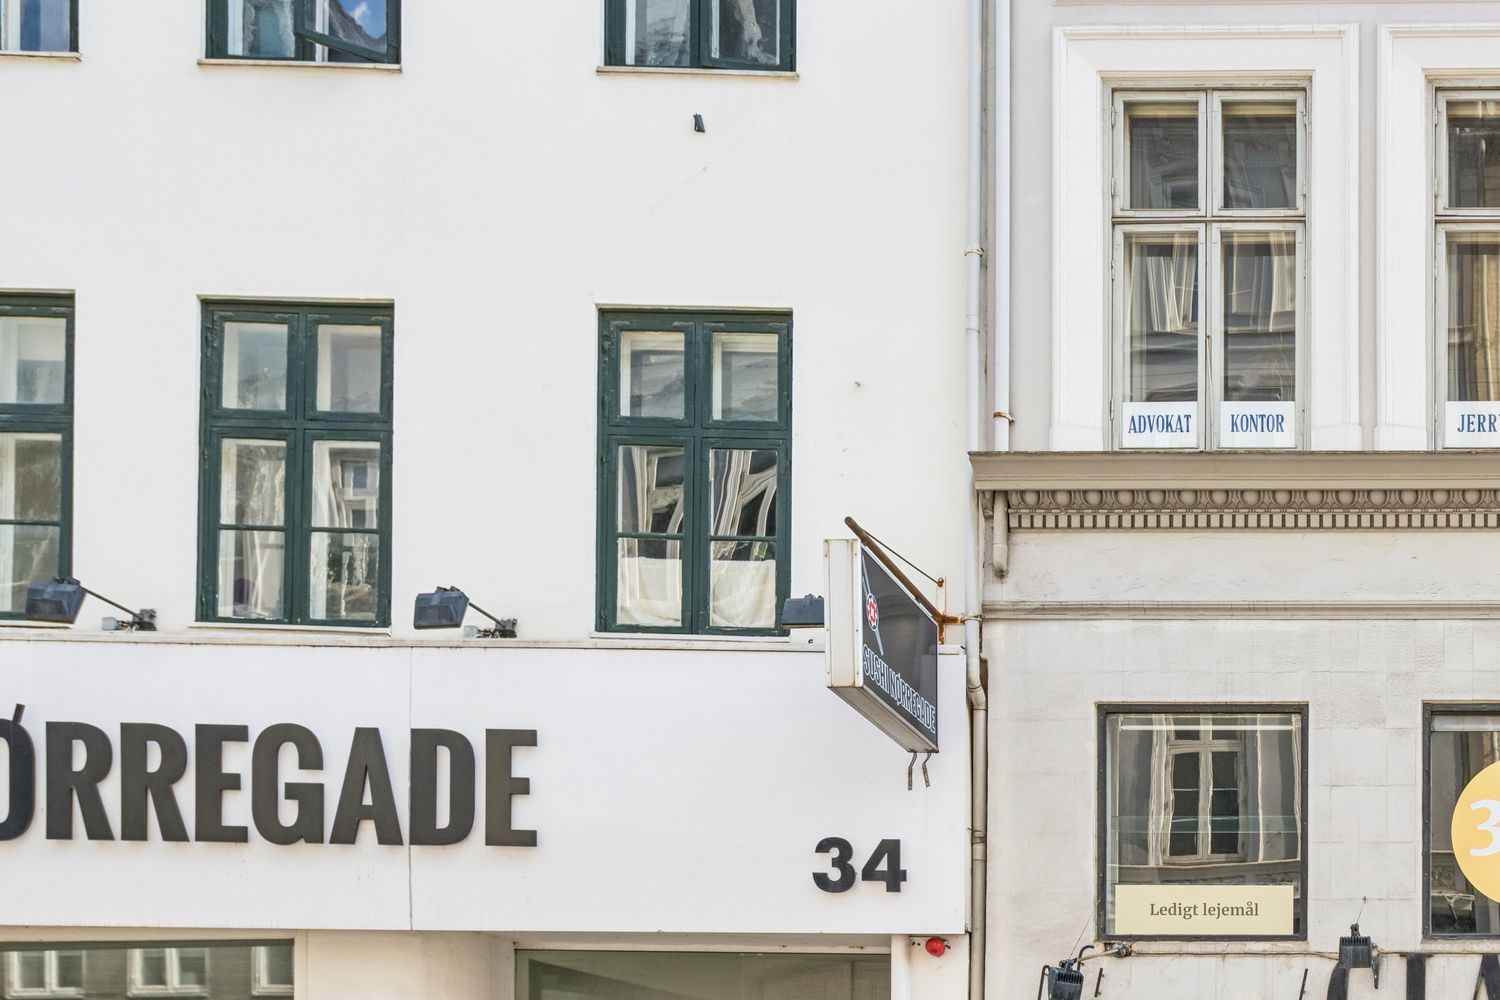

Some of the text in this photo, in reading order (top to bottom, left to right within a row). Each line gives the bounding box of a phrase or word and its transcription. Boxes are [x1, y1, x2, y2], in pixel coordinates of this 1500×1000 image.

[1128, 413, 1285, 434] ADVOKAT KONTOR
[863, 643, 889, 695] SUSHI
[812, 836, 908, 895] 34
[1150, 901, 1260, 920] Ledigt lejemål
